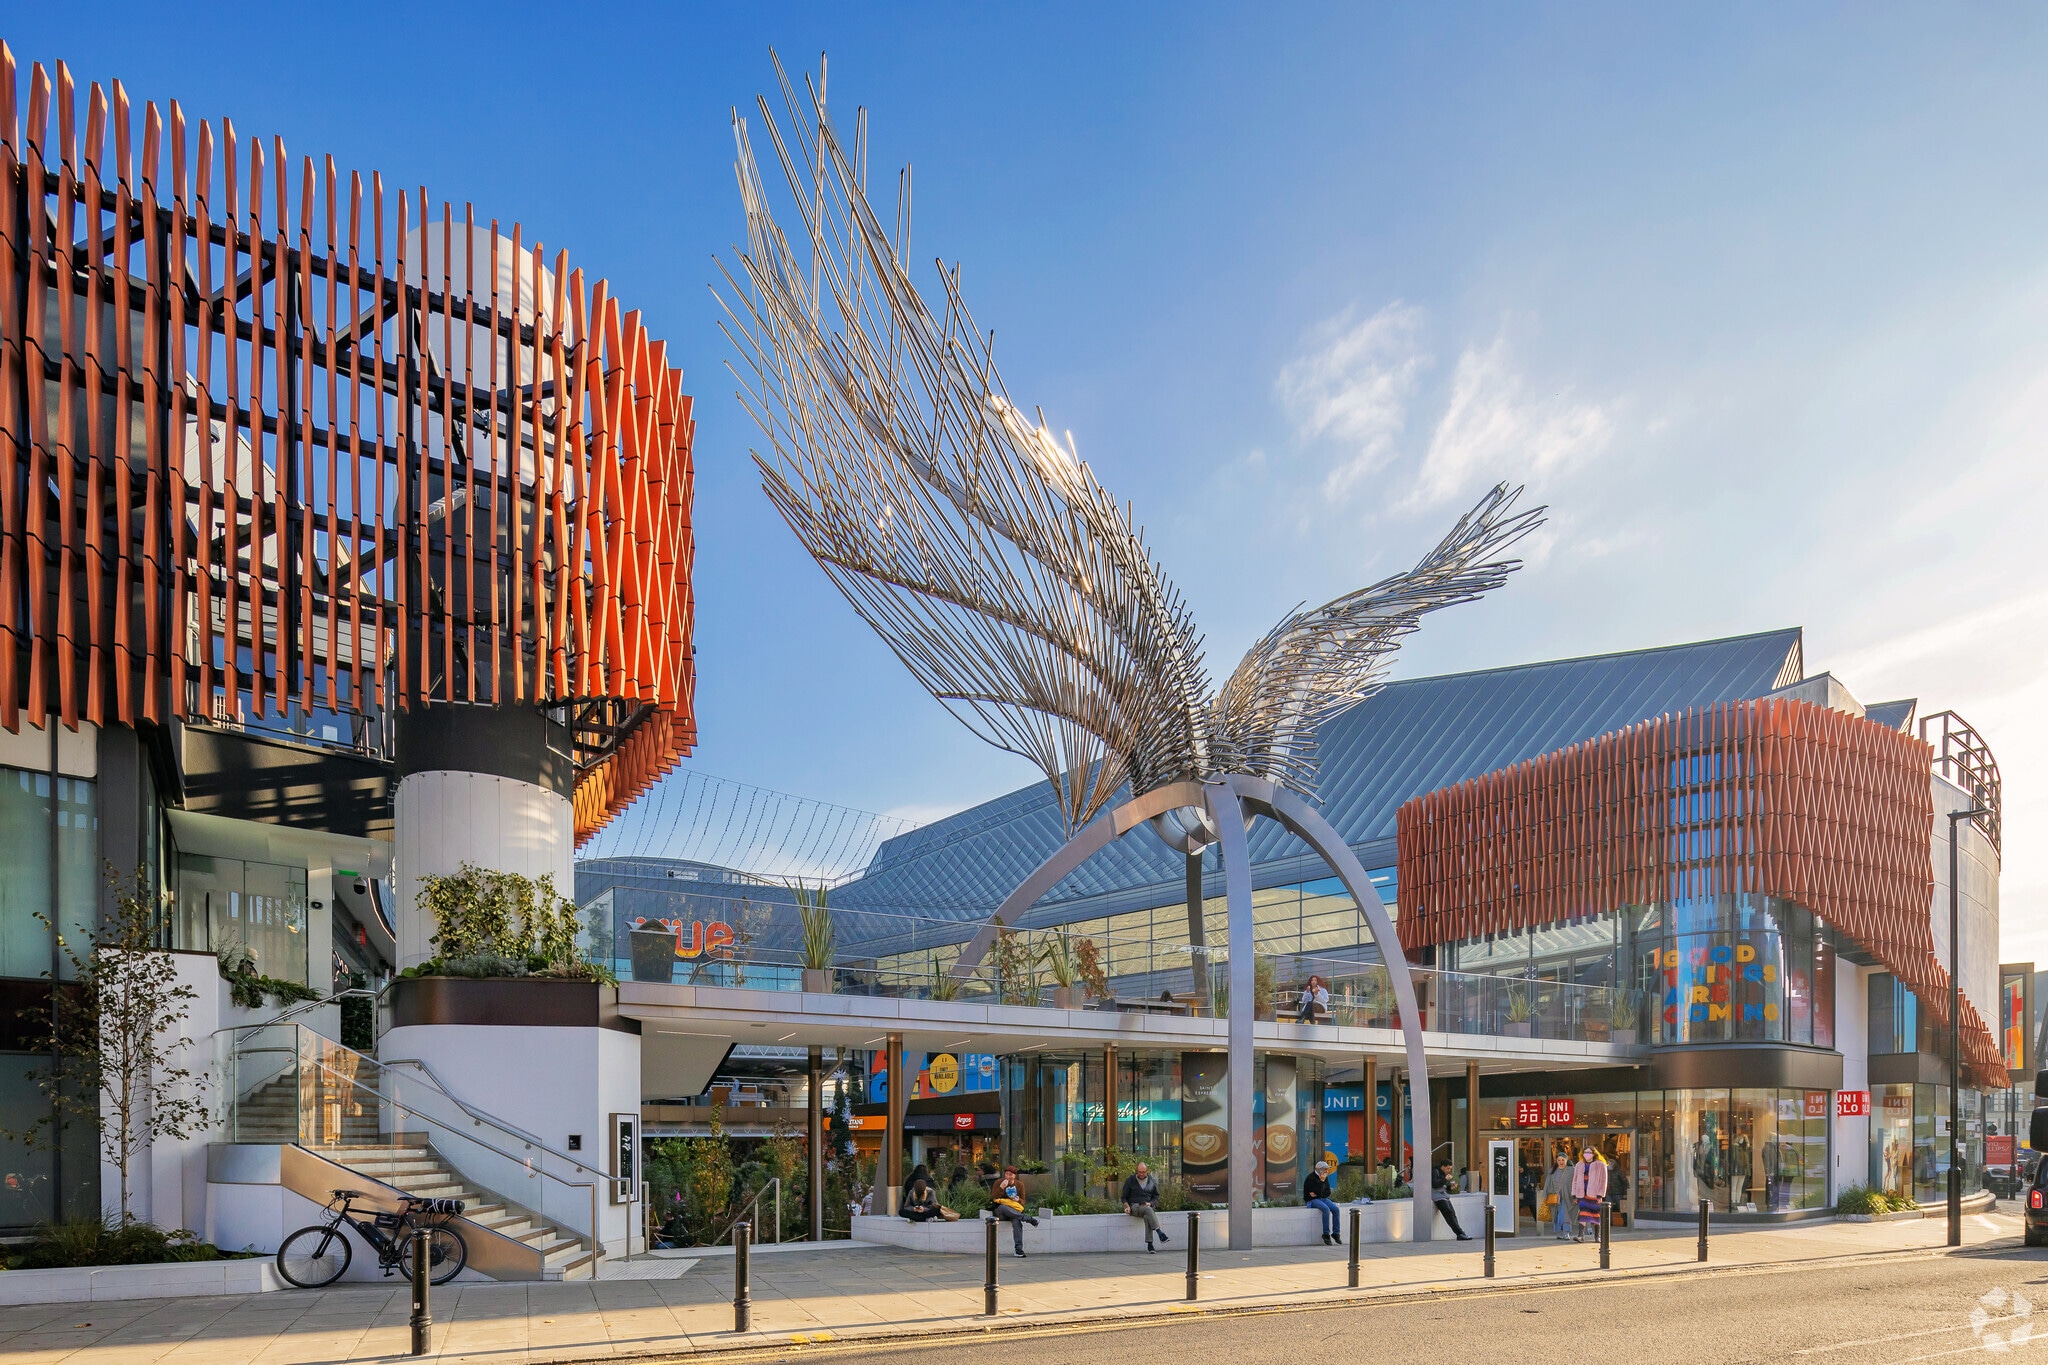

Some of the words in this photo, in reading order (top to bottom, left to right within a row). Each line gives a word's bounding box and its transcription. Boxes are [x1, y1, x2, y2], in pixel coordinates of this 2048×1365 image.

[635, 916, 735, 959] ue
[1663, 945, 1756, 968] GOOD
[1663, 964, 1777, 987] THINGS
[1664, 984, 1731, 1006] ARE
[1663, 1003, 1779, 1024] COMING
[1519, 1103, 1538, 1112] ユニ
[1549, 1102, 1568, 1112] UNI
[956, 1116, 972, 1125] Argos
[1549, 1113, 1570, 1123] QLO
